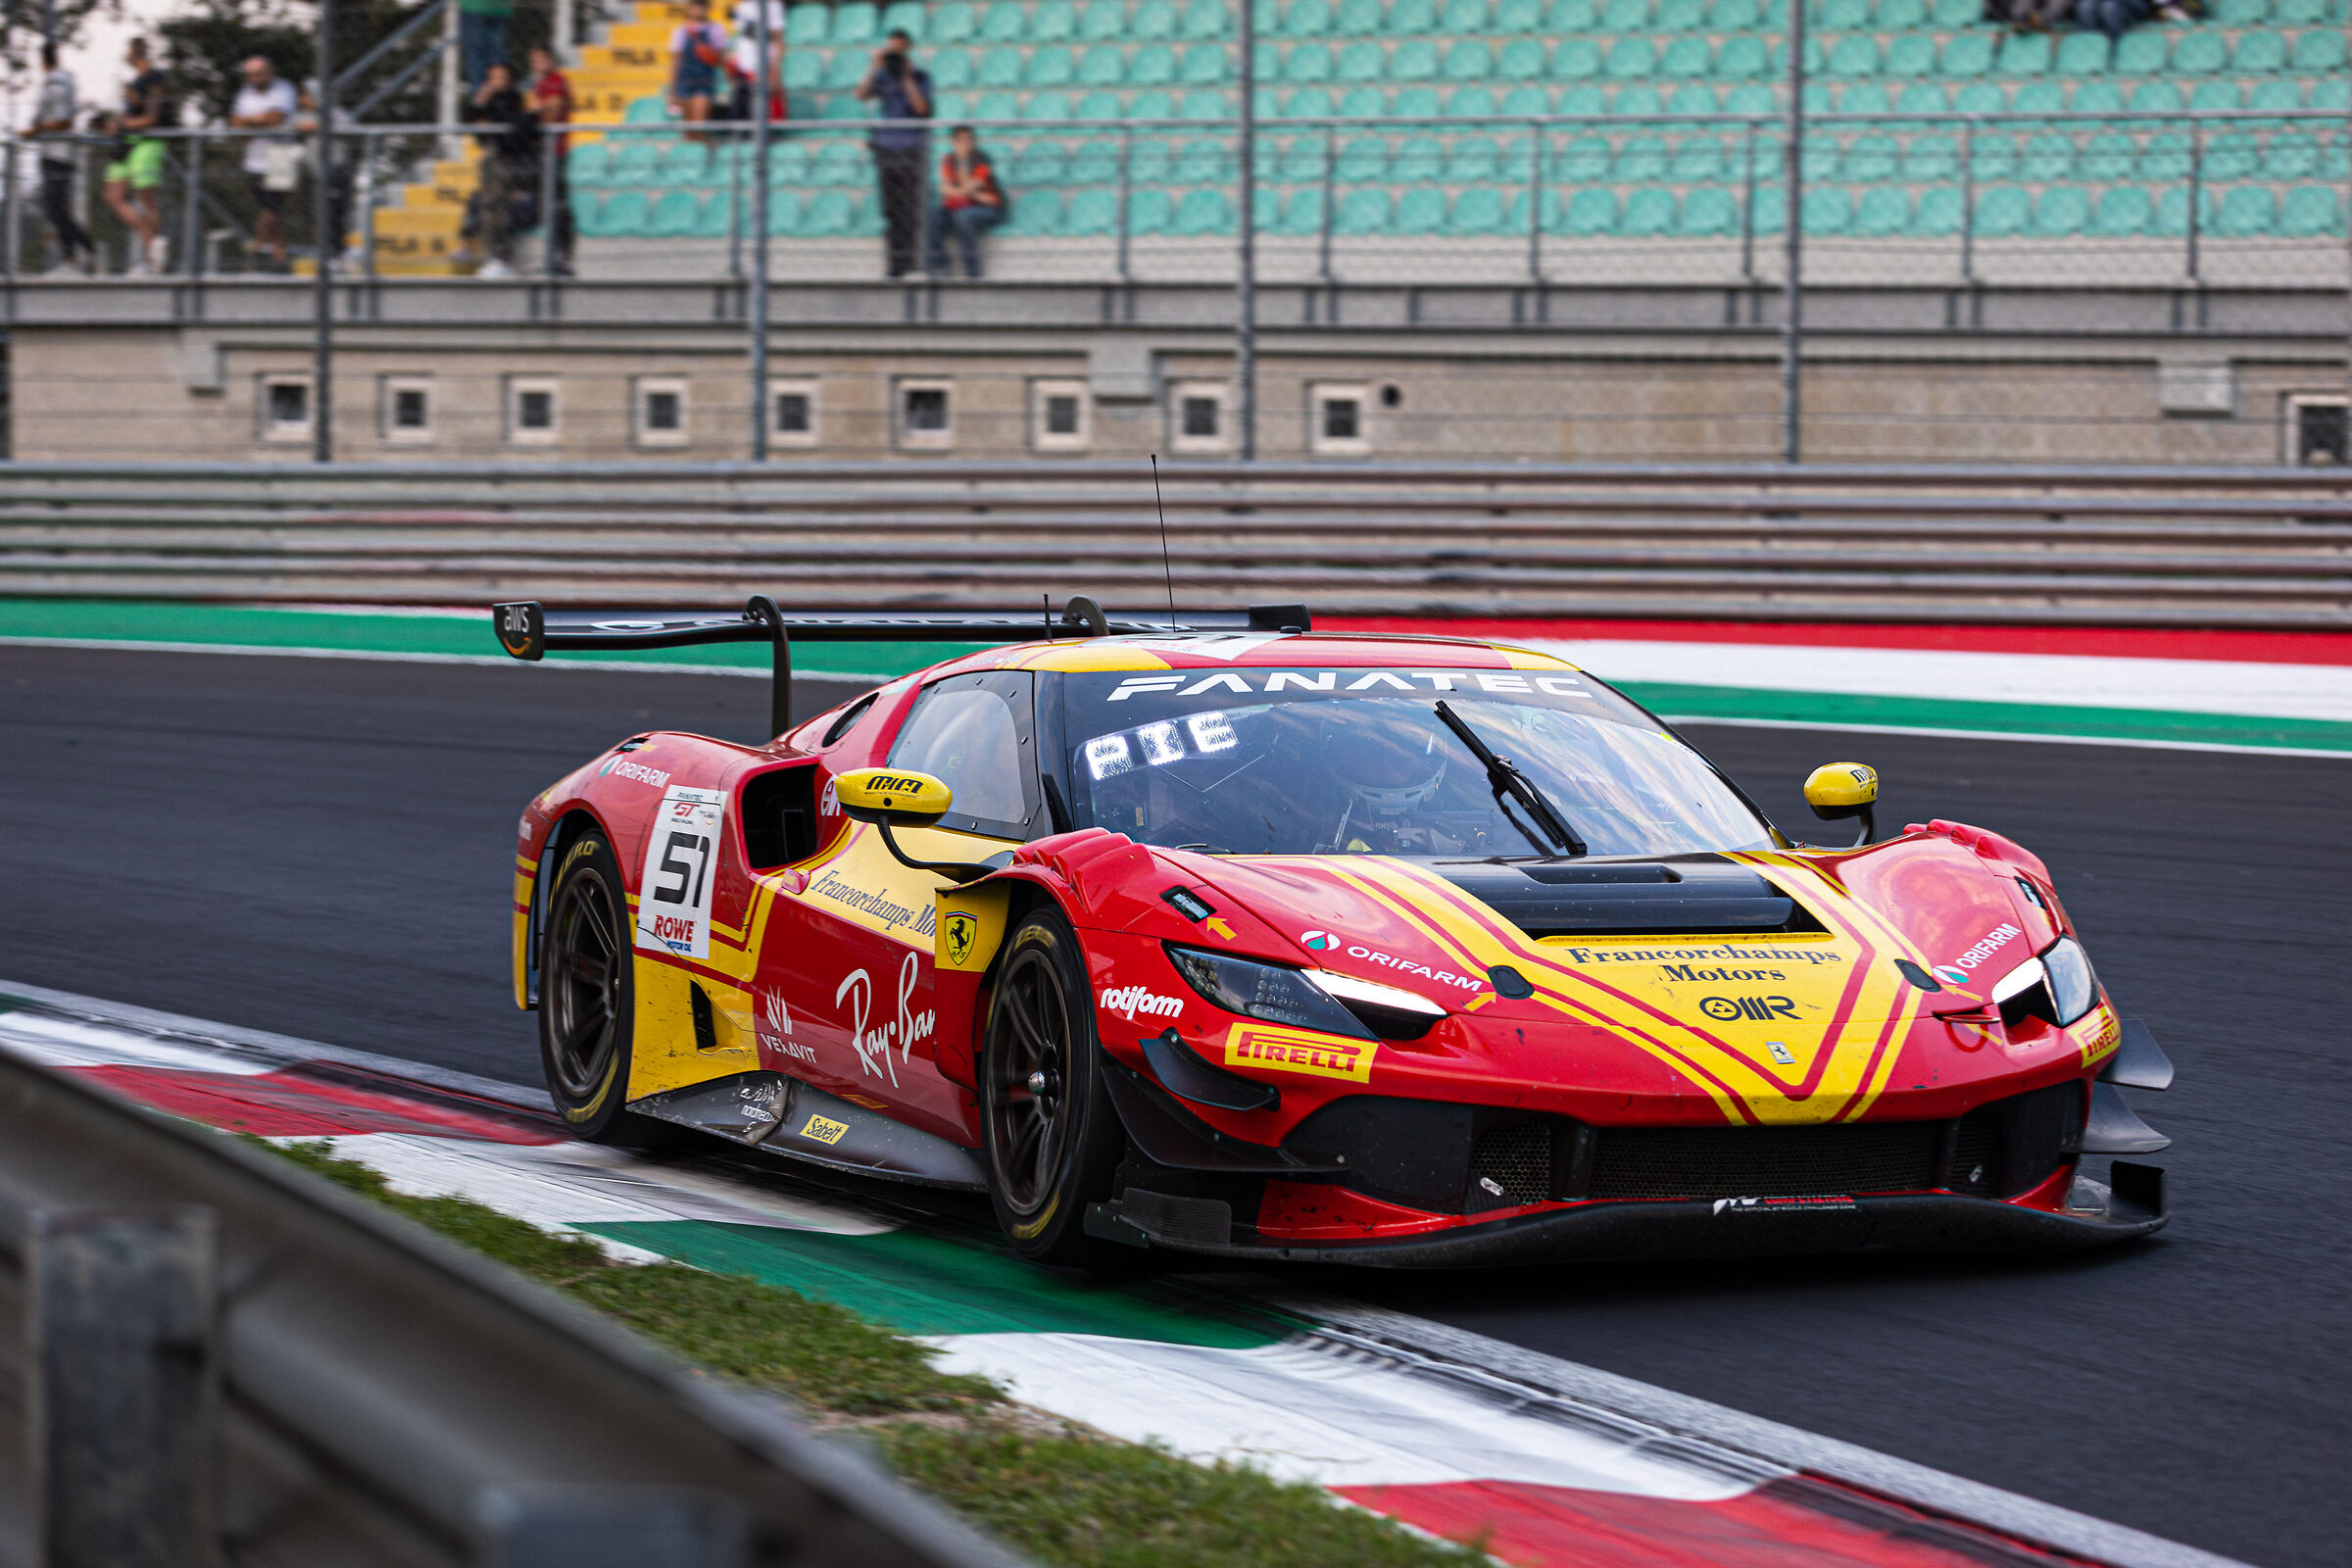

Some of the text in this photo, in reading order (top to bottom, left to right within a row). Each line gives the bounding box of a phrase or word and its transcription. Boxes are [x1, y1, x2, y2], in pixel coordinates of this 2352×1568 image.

[1106, 671, 1592, 702] FANATEC
[614, 760, 671, 789] ORIFARM
[653, 830, 710, 909] 51
[809, 869, 915, 931] Francorchamps
[654, 914, 695, 942] ROWE
[1564, 944, 1842, 965] Francorchamps
[1955, 922, 2022, 969] ORIFARM
[1347, 946, 1483, 993] ORIFARM
[1658, 964, 1787, 982] Motors
[1100, 986, 1184, 1020] rotiform
[1236, 1031, 1362, 1073] PIRELLI
[807, 1117, 842, 1143] Sabelt
